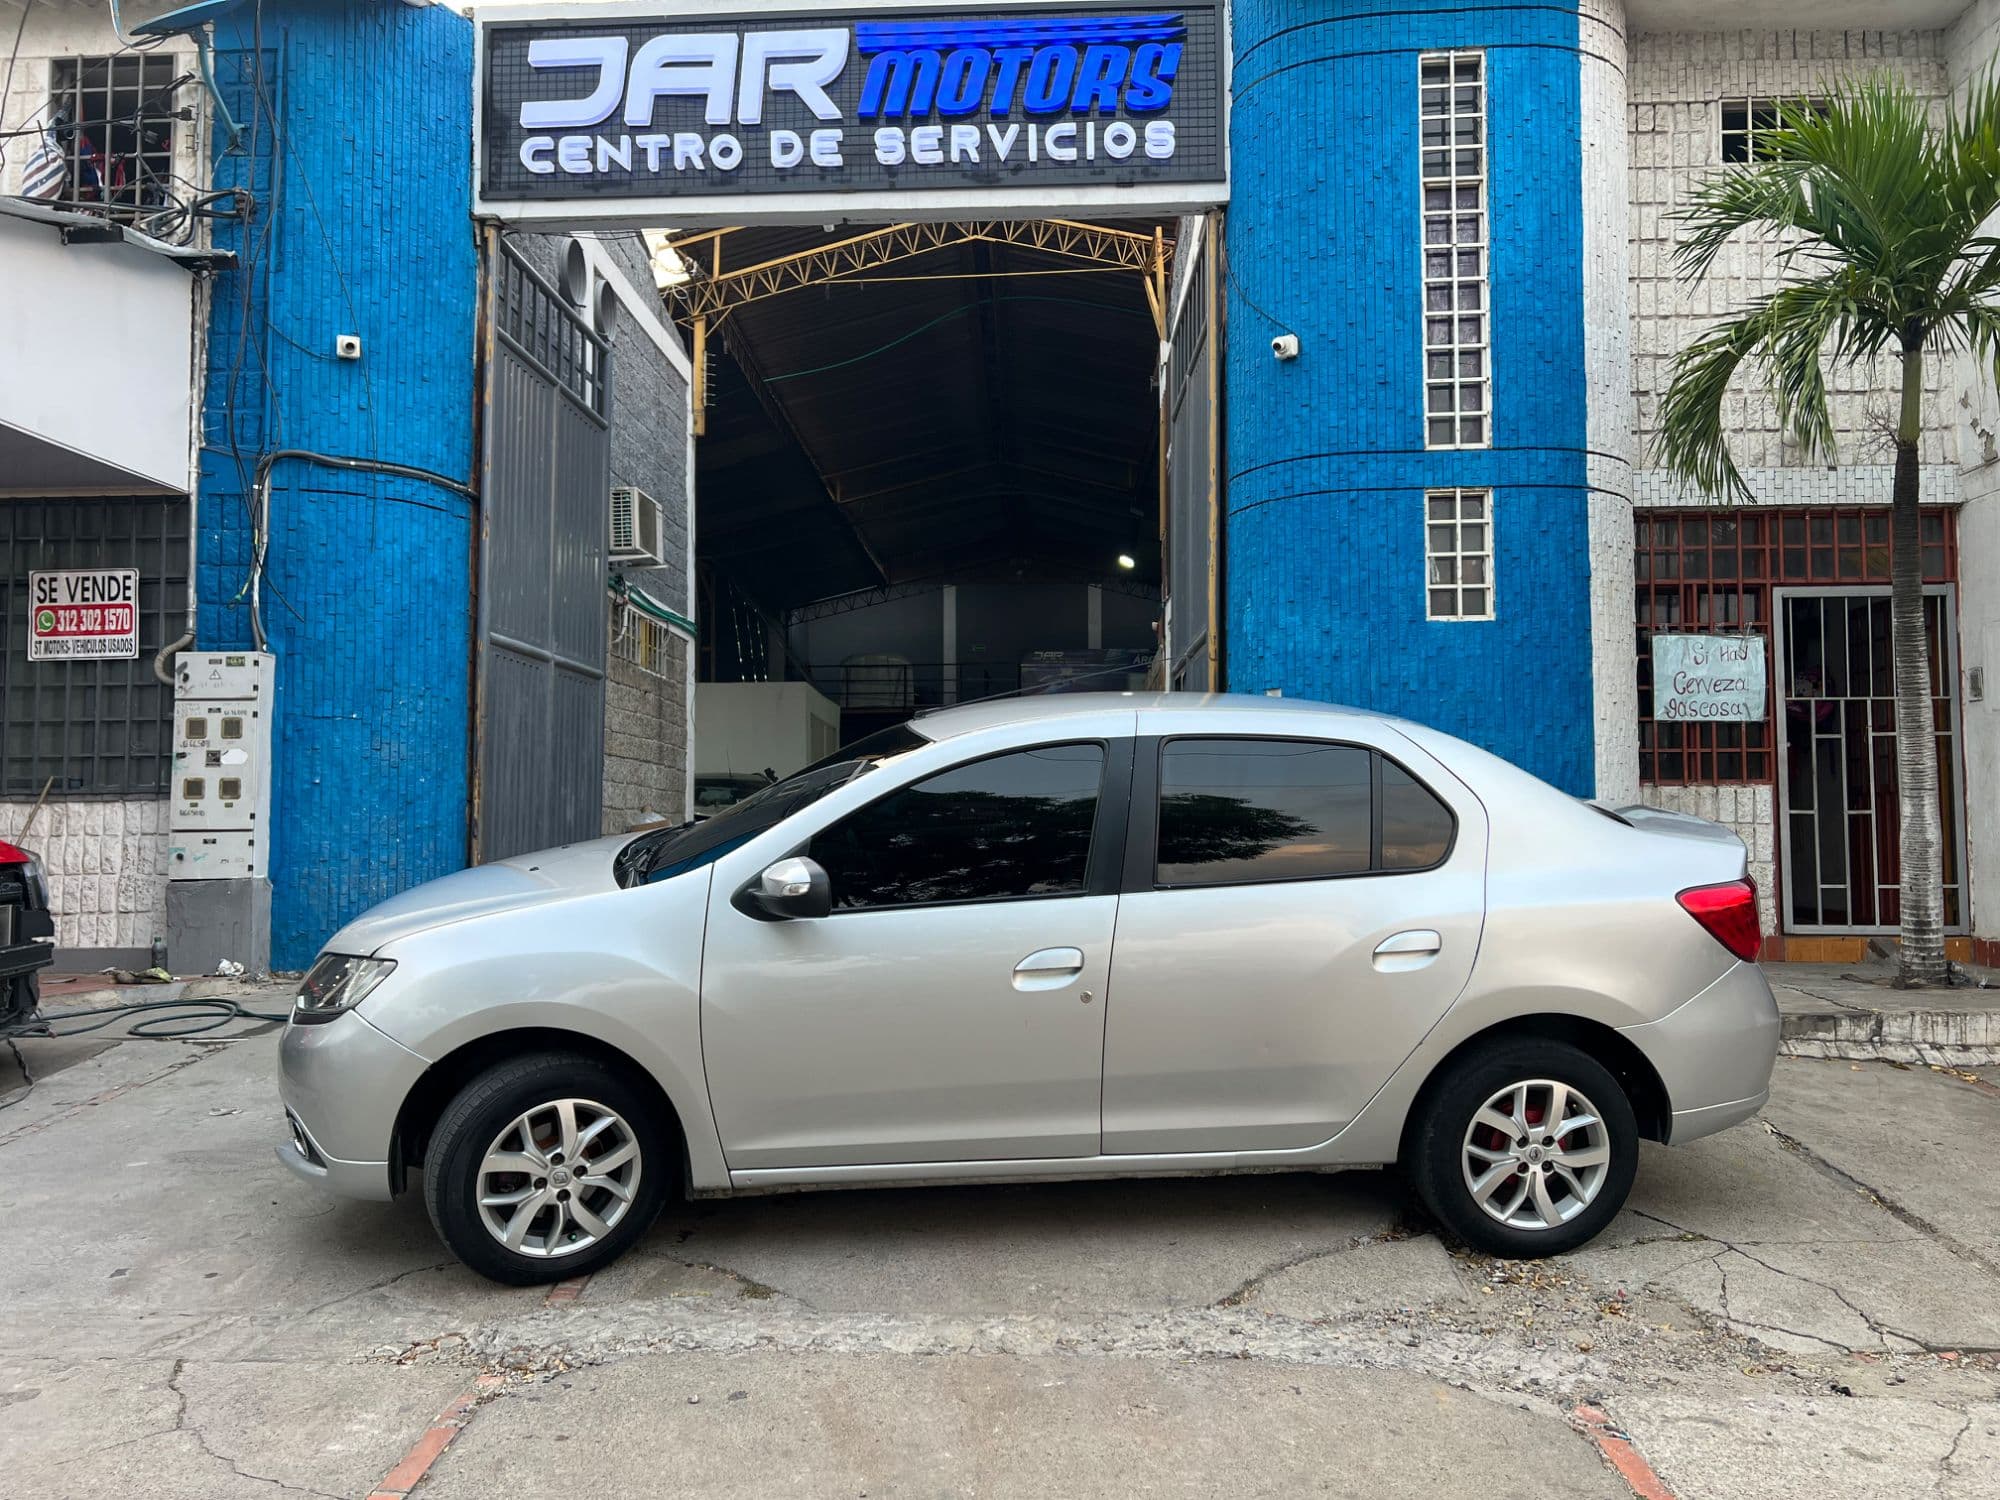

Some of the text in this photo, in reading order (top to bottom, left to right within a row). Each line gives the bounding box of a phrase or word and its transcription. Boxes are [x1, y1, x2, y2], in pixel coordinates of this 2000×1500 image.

[520, 28, 849, 128] JAR
[857, 43, 1184, 117] MOTORS
[519, 121, 1176, 173] CENTRO DE SERVICIOS
[36, 575, 132, 604] SE VENDE
[57, 607, 131, 632] 312 302 1570
[108, 638, 133, 653] USADOS
